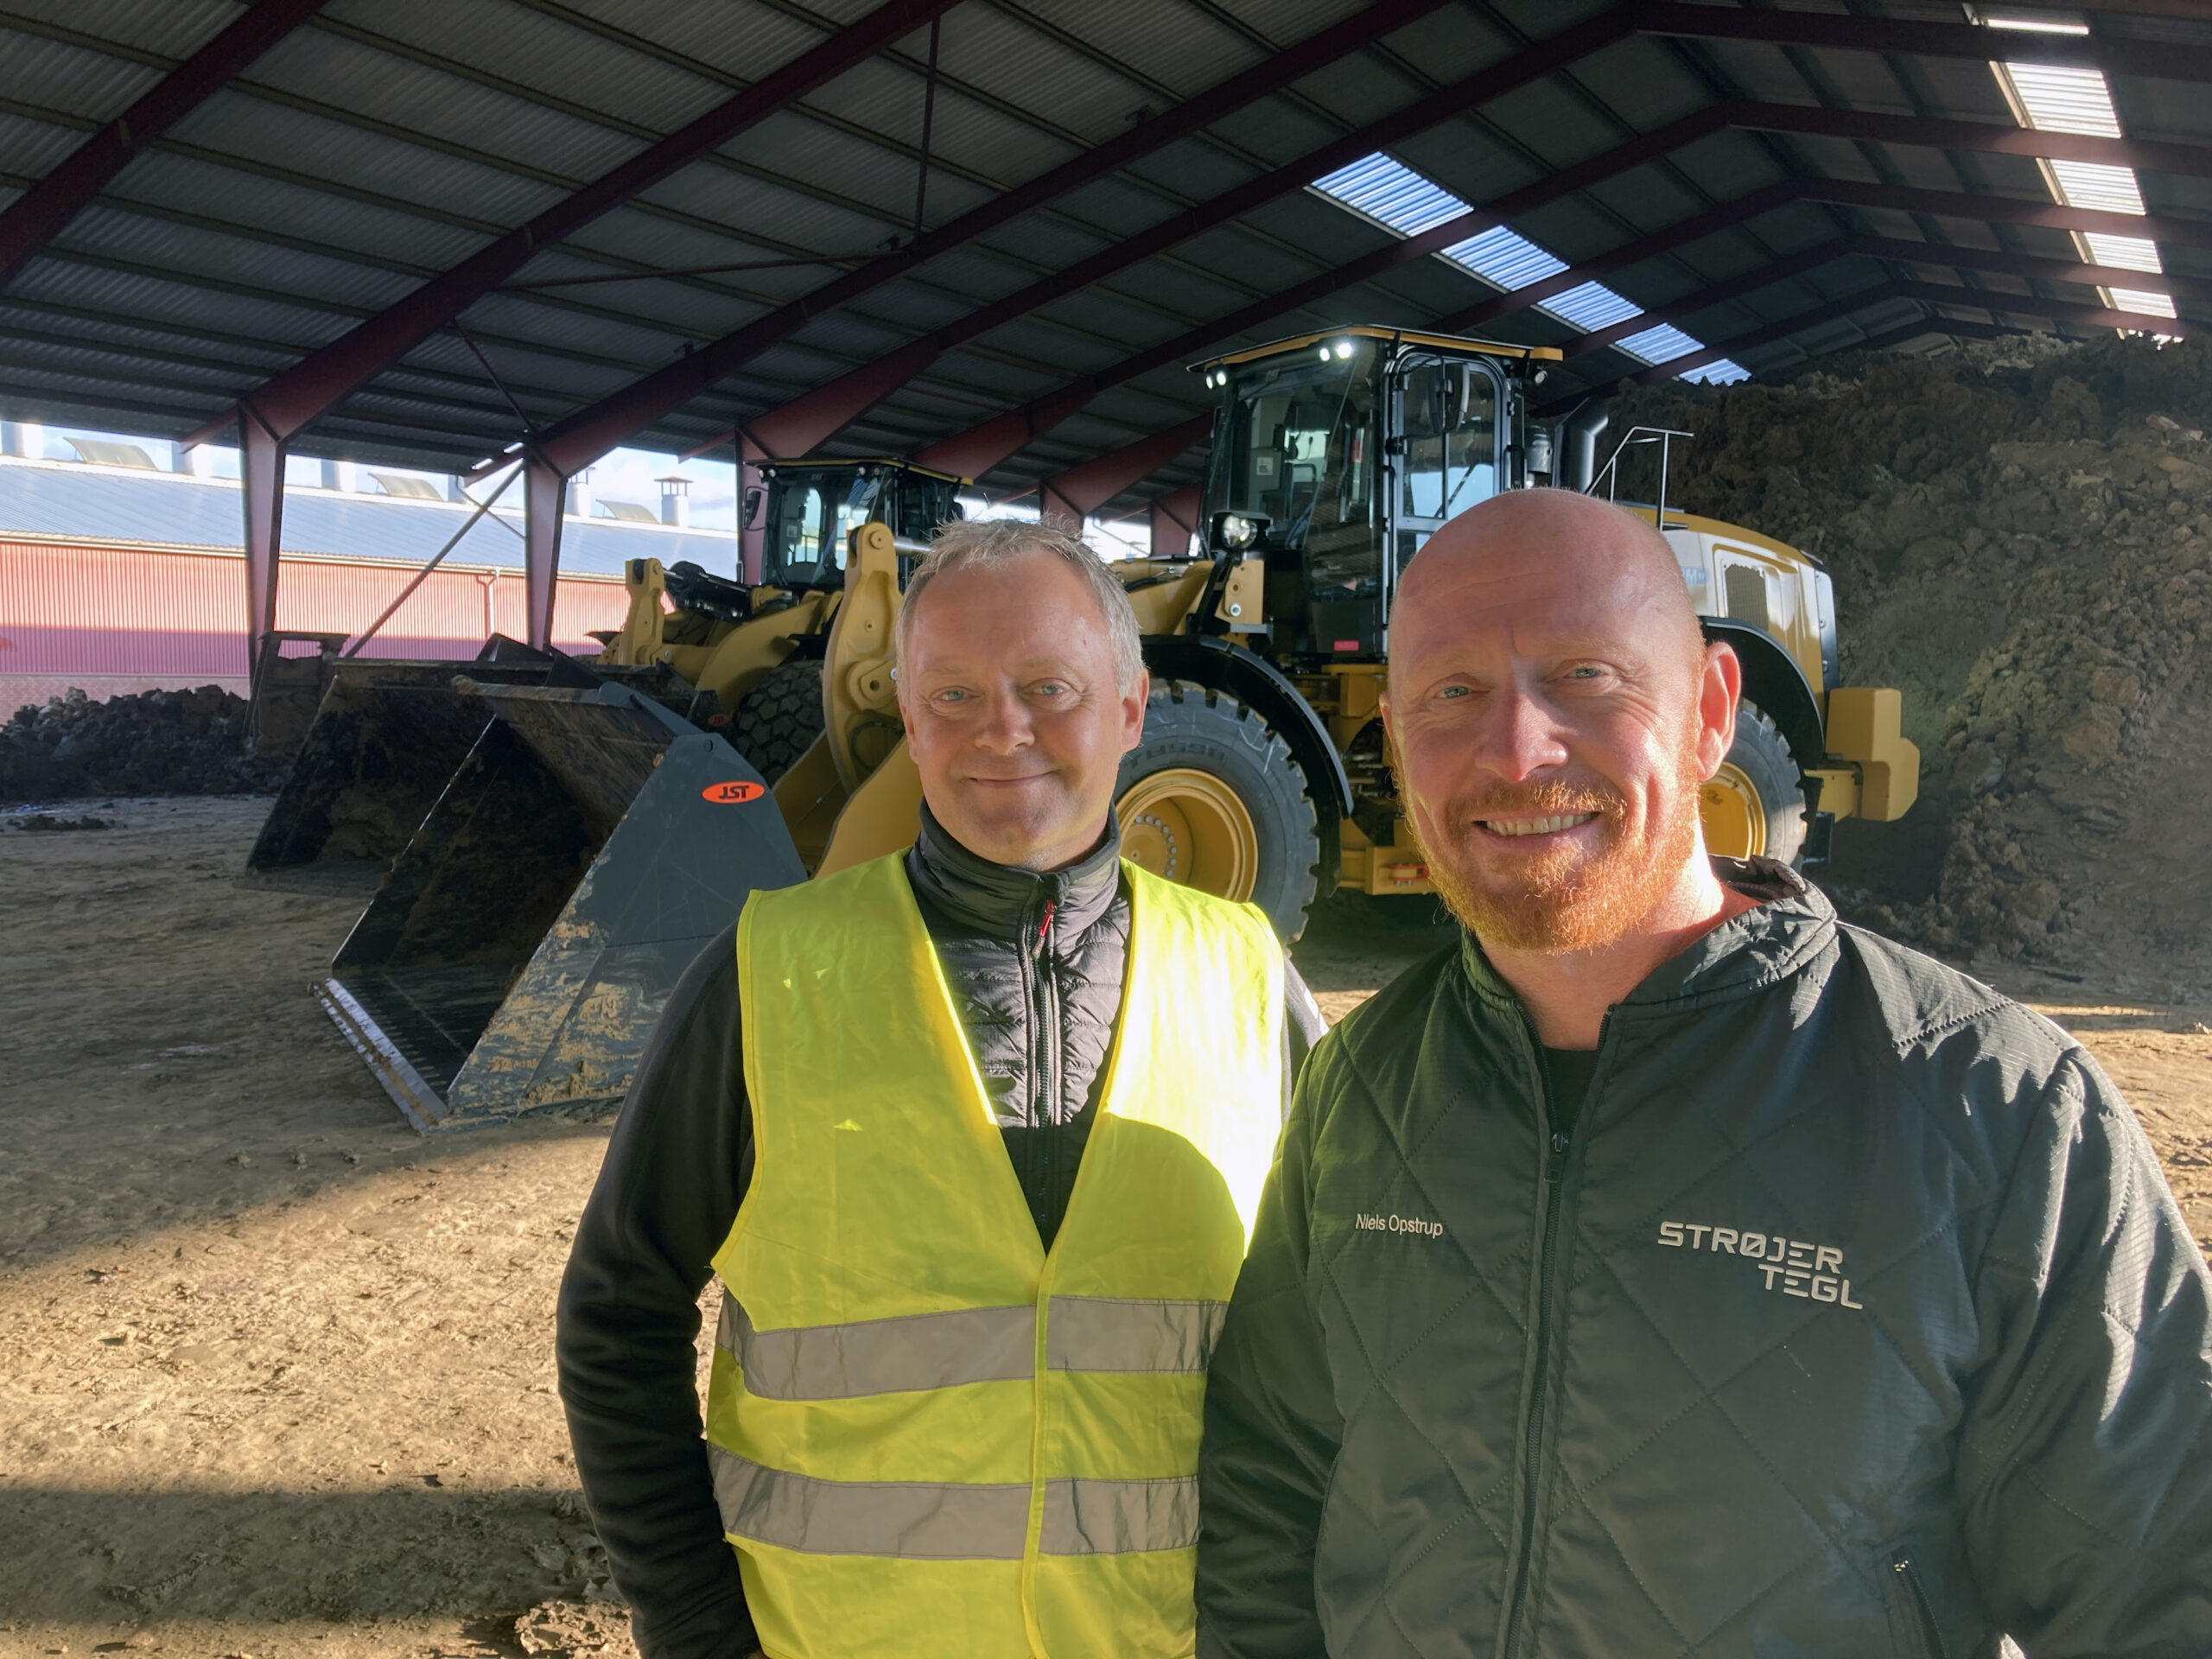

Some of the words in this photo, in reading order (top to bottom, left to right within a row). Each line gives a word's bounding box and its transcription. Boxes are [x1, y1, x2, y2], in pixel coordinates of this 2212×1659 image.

[1355, 1213, 1385, 1230] Niels
[1388, 1214, 1443, 1239] Opstrup
[1657, 1220, 1844, 1274] STRØJER
[1758, 1263, 1863, 1310] TEGL
